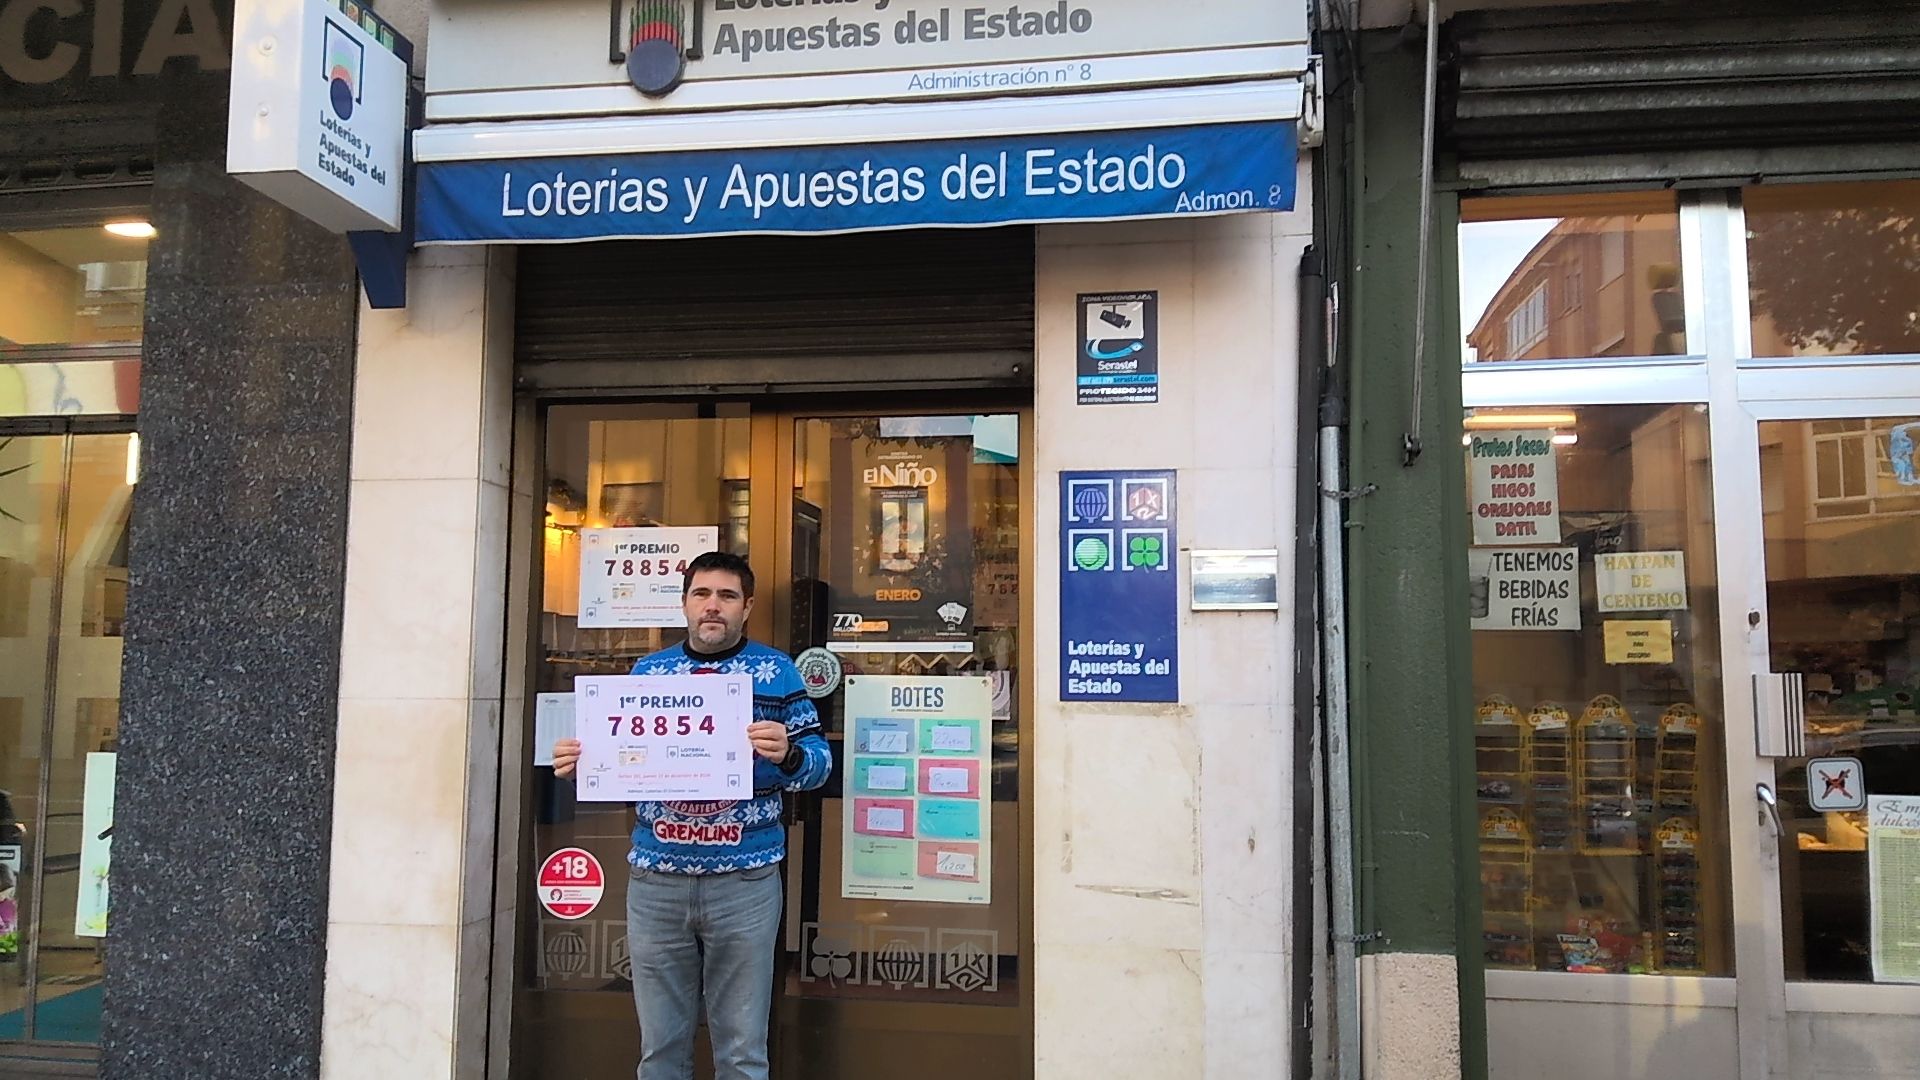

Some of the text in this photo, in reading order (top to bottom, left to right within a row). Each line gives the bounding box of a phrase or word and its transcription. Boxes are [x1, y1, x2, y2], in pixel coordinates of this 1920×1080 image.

[713, 1, 1093, 62] Apuestas del Estado
[908, 65, 1049, 91] Administración
[1080, 63, 1092, 81] 8
[319, 132, 386, 186] Apuestas del
[365, 143, 371, 159] y
[318, 151, 355, 187] Estado
[502, 144, 1186, 224] Loterias y Apuestas del Estado
[1175, 184, 1282, 213] Admon. 8
[1097, 359, 1138, 371] Serastel
[1079, 387, 1136, 395] PROTEGIDO
[863, 461, 937, 488] El Niño
[1491, 463, 1534, 479] PASAS
[1492, 482, 1536, 498] HIGOS
[1478, 501, 1552, 518] OREJONES
[1495, 521, 1537, 536] DATIL
[630, 543, 680, 555] PREMIO
[604, 559, 687, 577] 78854
[1492, 552, 1574, 572] TENEMOS
[1604, 555, 1675, 570] HAY PAN
[1499, 580, 1569, 599] BEBIDAS
[1631, 575, 1652, 588] DE
[875, 588, 921, 601] ENERO
[1602, 592, 1683, 609] CENTENO
[833, 613, 862, 627] 770
[1511, 602, 1558, 626] FRÍAS
[1068, 640, 1145, 660] Loterías y
[1068, 659, 1170, 678] Apuestas del
[1068, 678, 1122, 695] Estado
[619, 694, 704, 709] 1er PREMIO
[891, 686, 944, 708] BOTES
[607, 714, 715, 737] 78854
[688, 802, 718, 813] AFTER
[552, 856, 588, 879] +18
